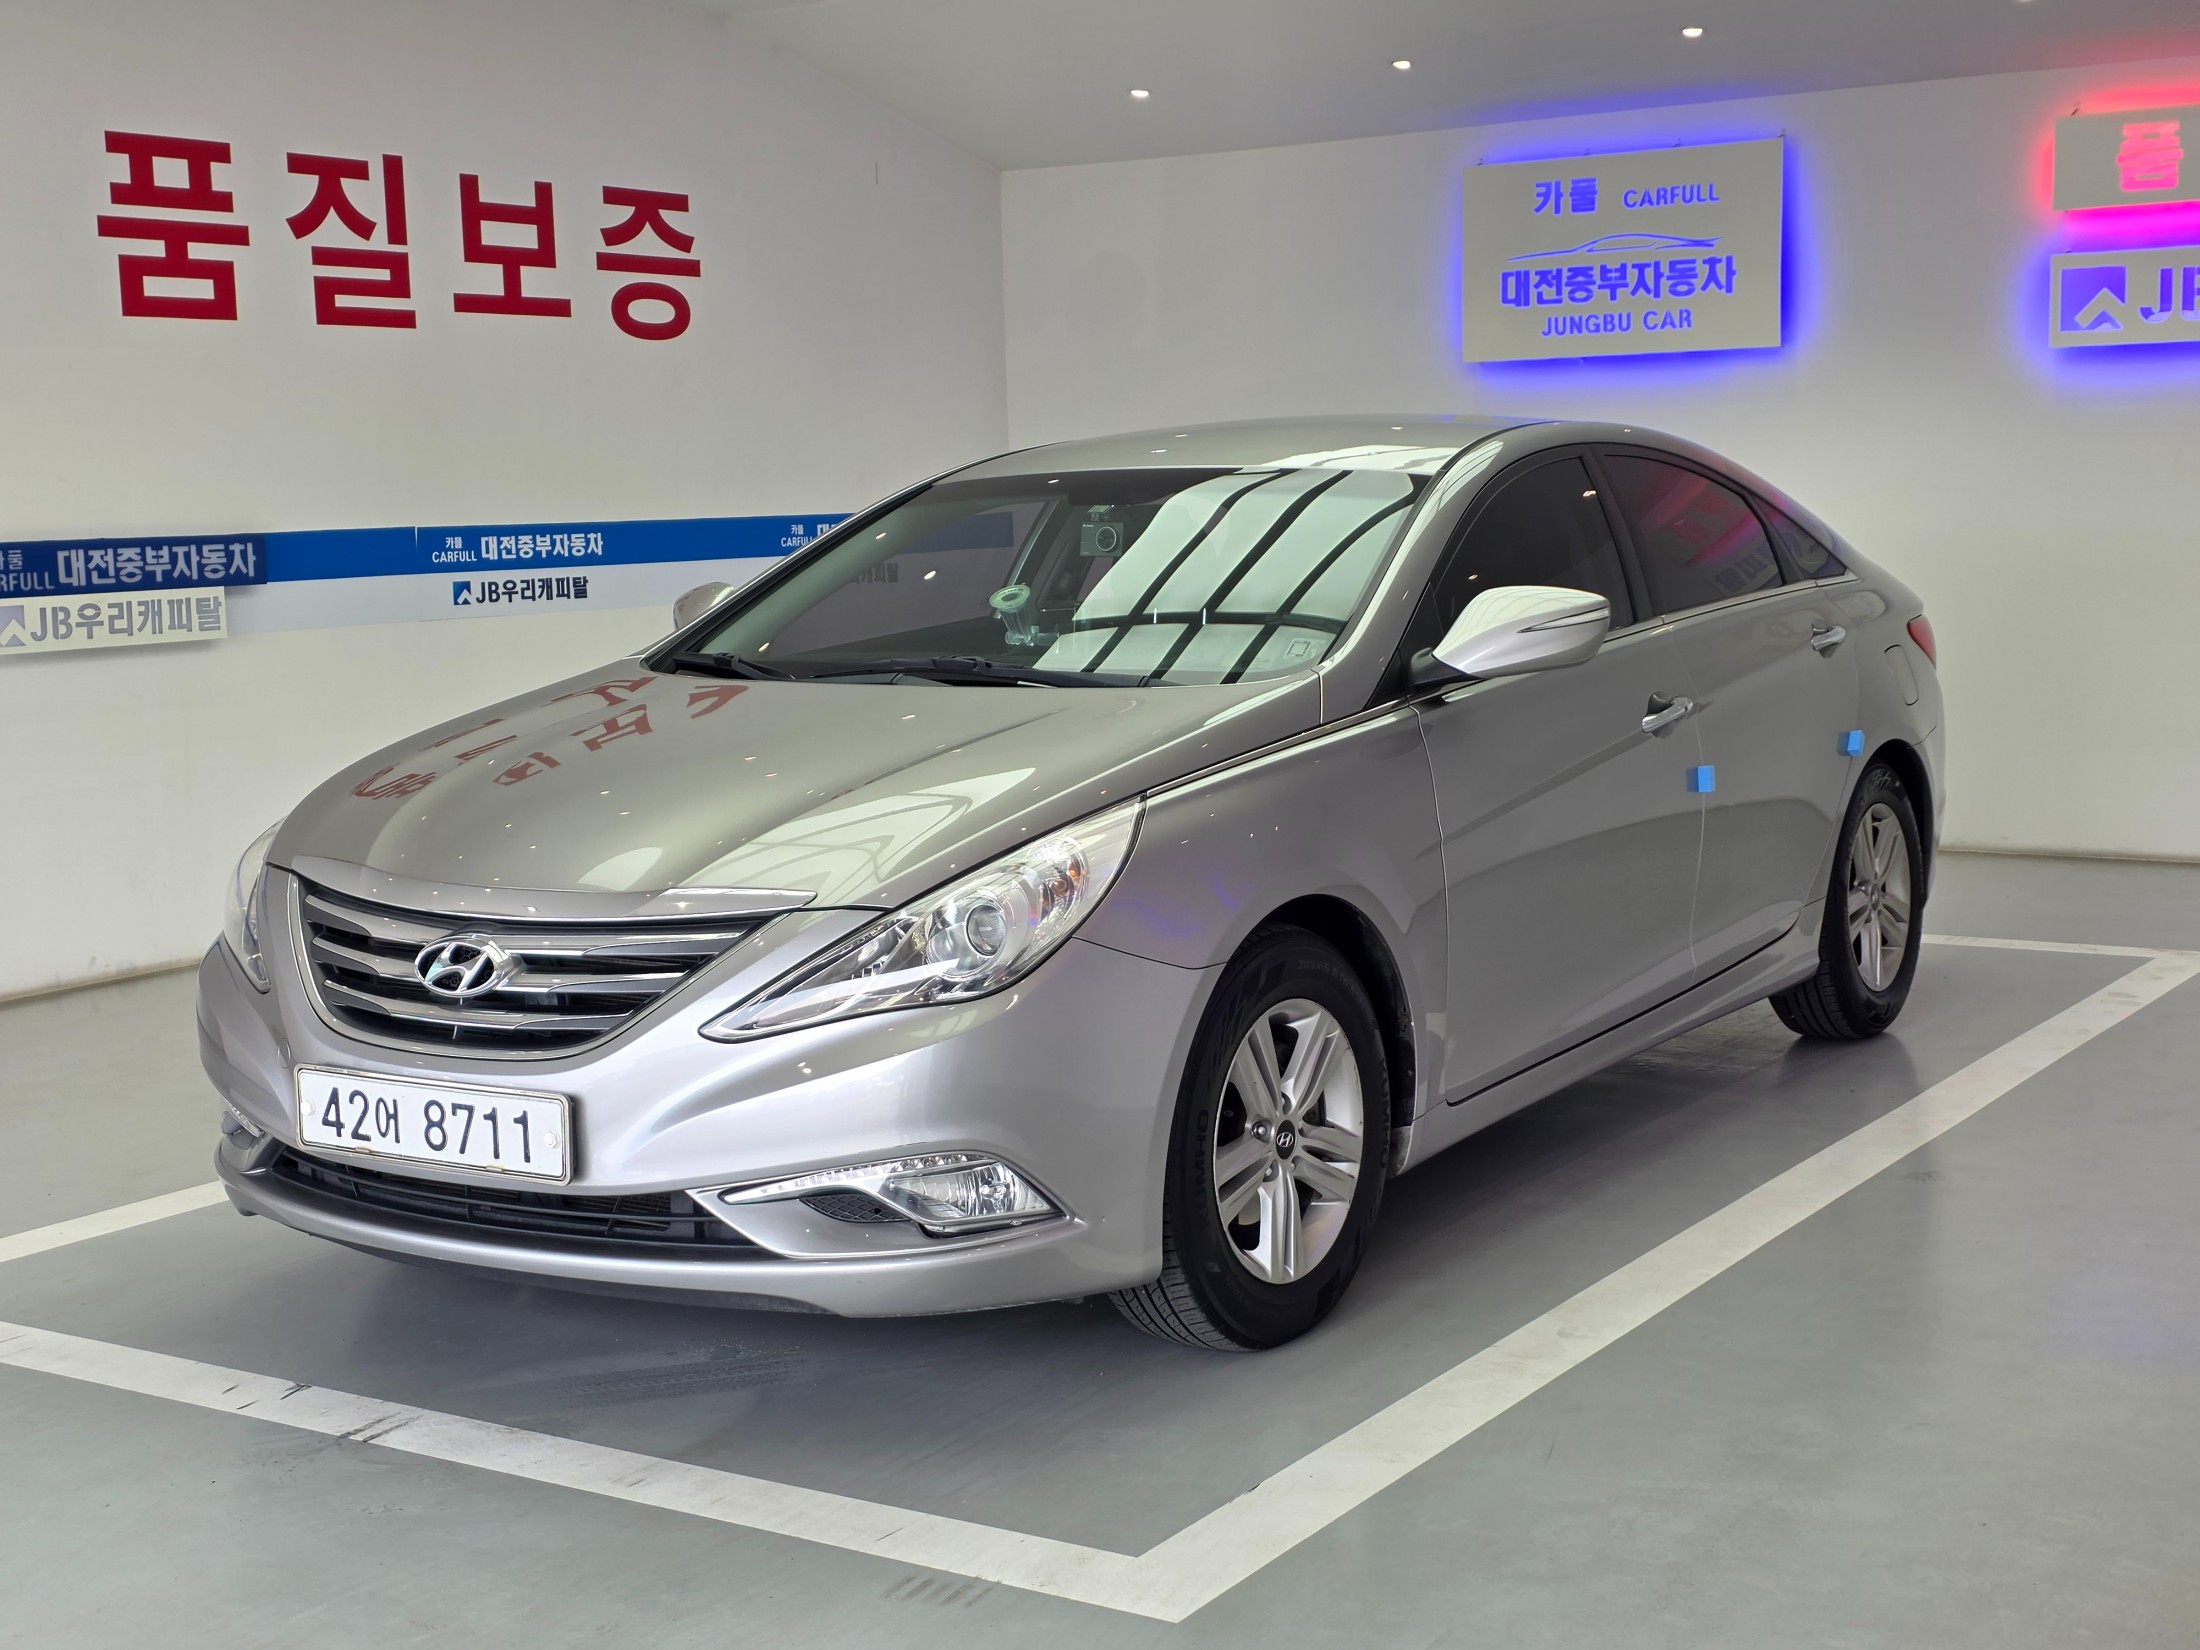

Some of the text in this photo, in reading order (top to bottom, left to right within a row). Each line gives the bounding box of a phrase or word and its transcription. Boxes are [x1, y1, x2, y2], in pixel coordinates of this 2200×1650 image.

[1622, 183, 1720, 209] CARFULL
[97, 130, 701, 341] 품질보증
[1501, 256, 1737, 308] 대전중부자동차
[1541, 308, 1694, 337] JUNGBU CAR
[57, 542, 257, 587] 대전중부자동차
[432, 550, 478, 563] CARFULL
[480, 533, 604, 560] 대전중부자동차
[475, 576, 589, 604] JB우리캐피탈
[30, 595, 222, 642] JB우리캐피탈
[321, 1087, 532, 1164] 42어 8711
